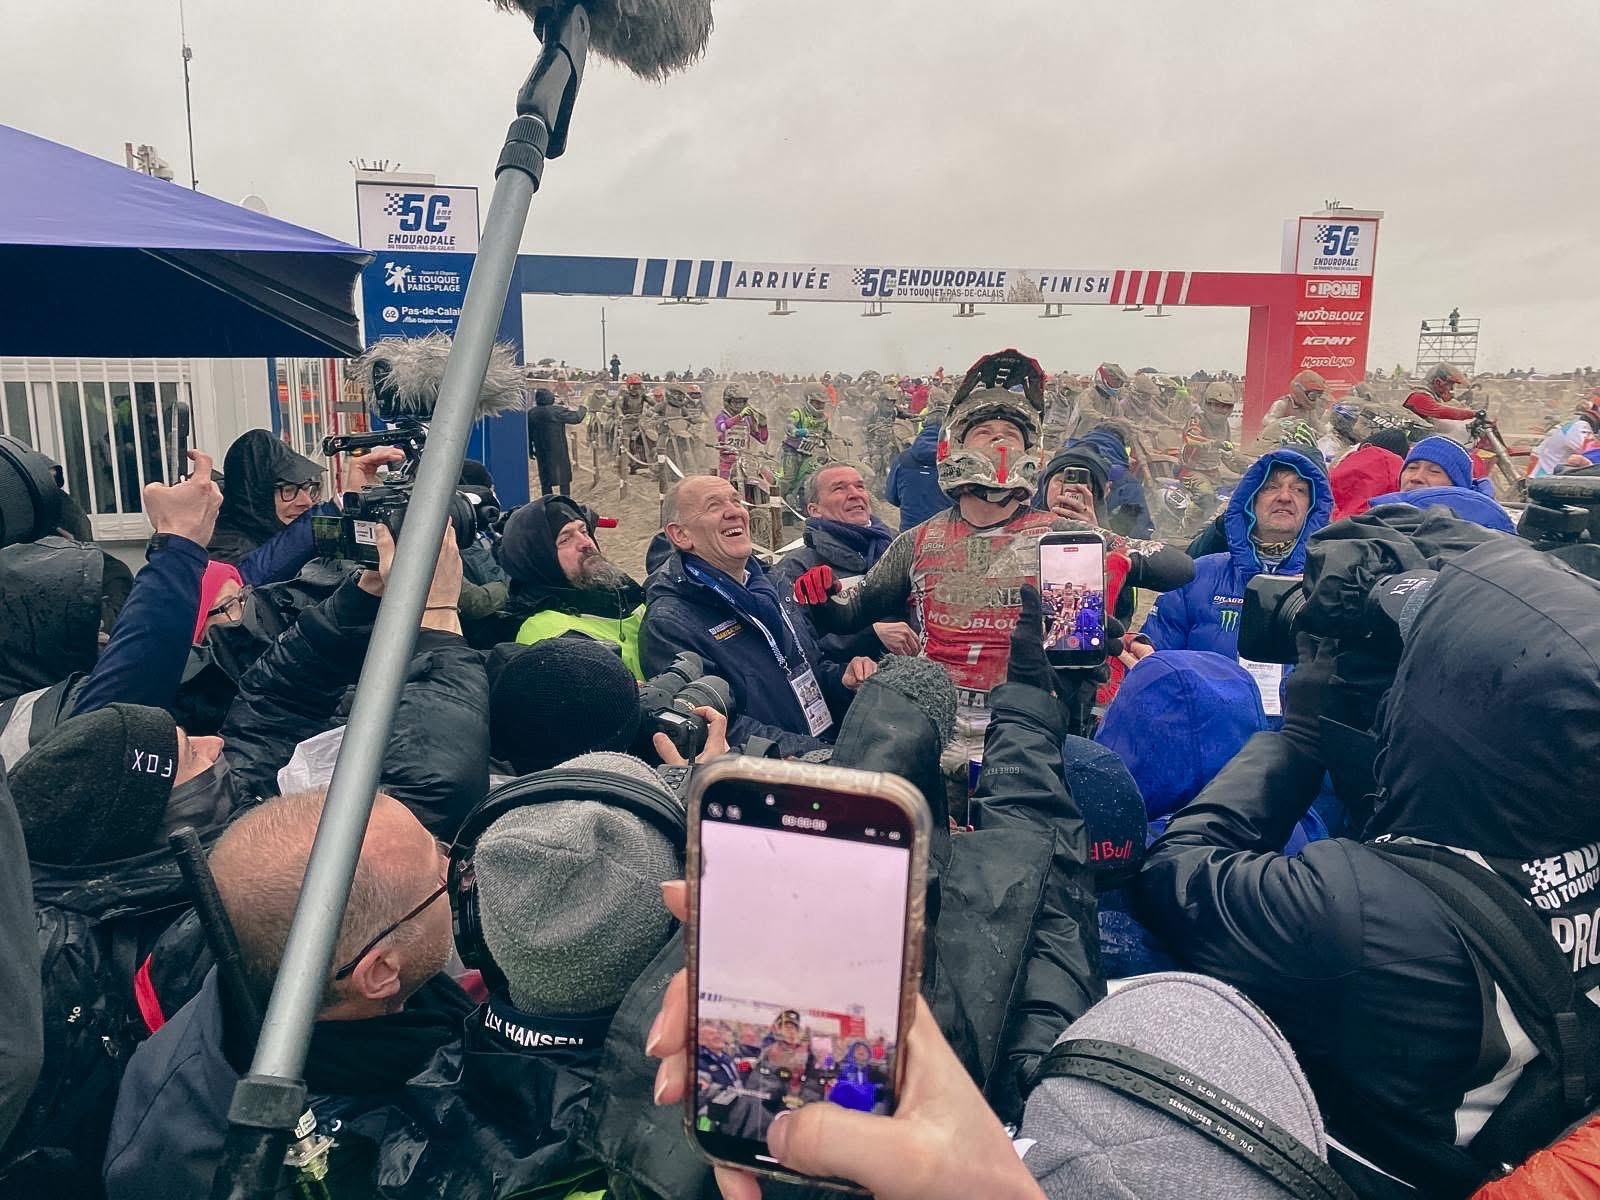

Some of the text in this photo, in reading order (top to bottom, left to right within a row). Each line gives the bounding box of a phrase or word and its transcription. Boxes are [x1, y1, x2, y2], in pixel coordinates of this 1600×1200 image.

[388, 234, 456, 246] ENDUROPALE
[1314, 257, 1359, 266] ENDUROPALE
[407, 275, 460, 284] LE TOUQUET
[735, 267, 830, 289] ARRIVÉE
[898, 269, 1007, 287] ENDUROPALE
[1039, 276, 1110, 293] FINISH
[407, 284, 461, 292] PARIS-PLAGE
[897, 288, 908, 296] DU
[1318, 282, 1360, 296] IPONE
[385, 310, 397, 318] 62
[402, 307, 462, 316] Pas-de-Calai
[1297, 307, 1364, 321] MOTOBLOUZ
[1302, 336, 1357, 346] KENNY
[132, 749, 172, 777] FOX
[1102, 839, 1132, 859] Bull
[1543, 841, 1600, 887] END
[1534, 889, 1562, 910] DU
